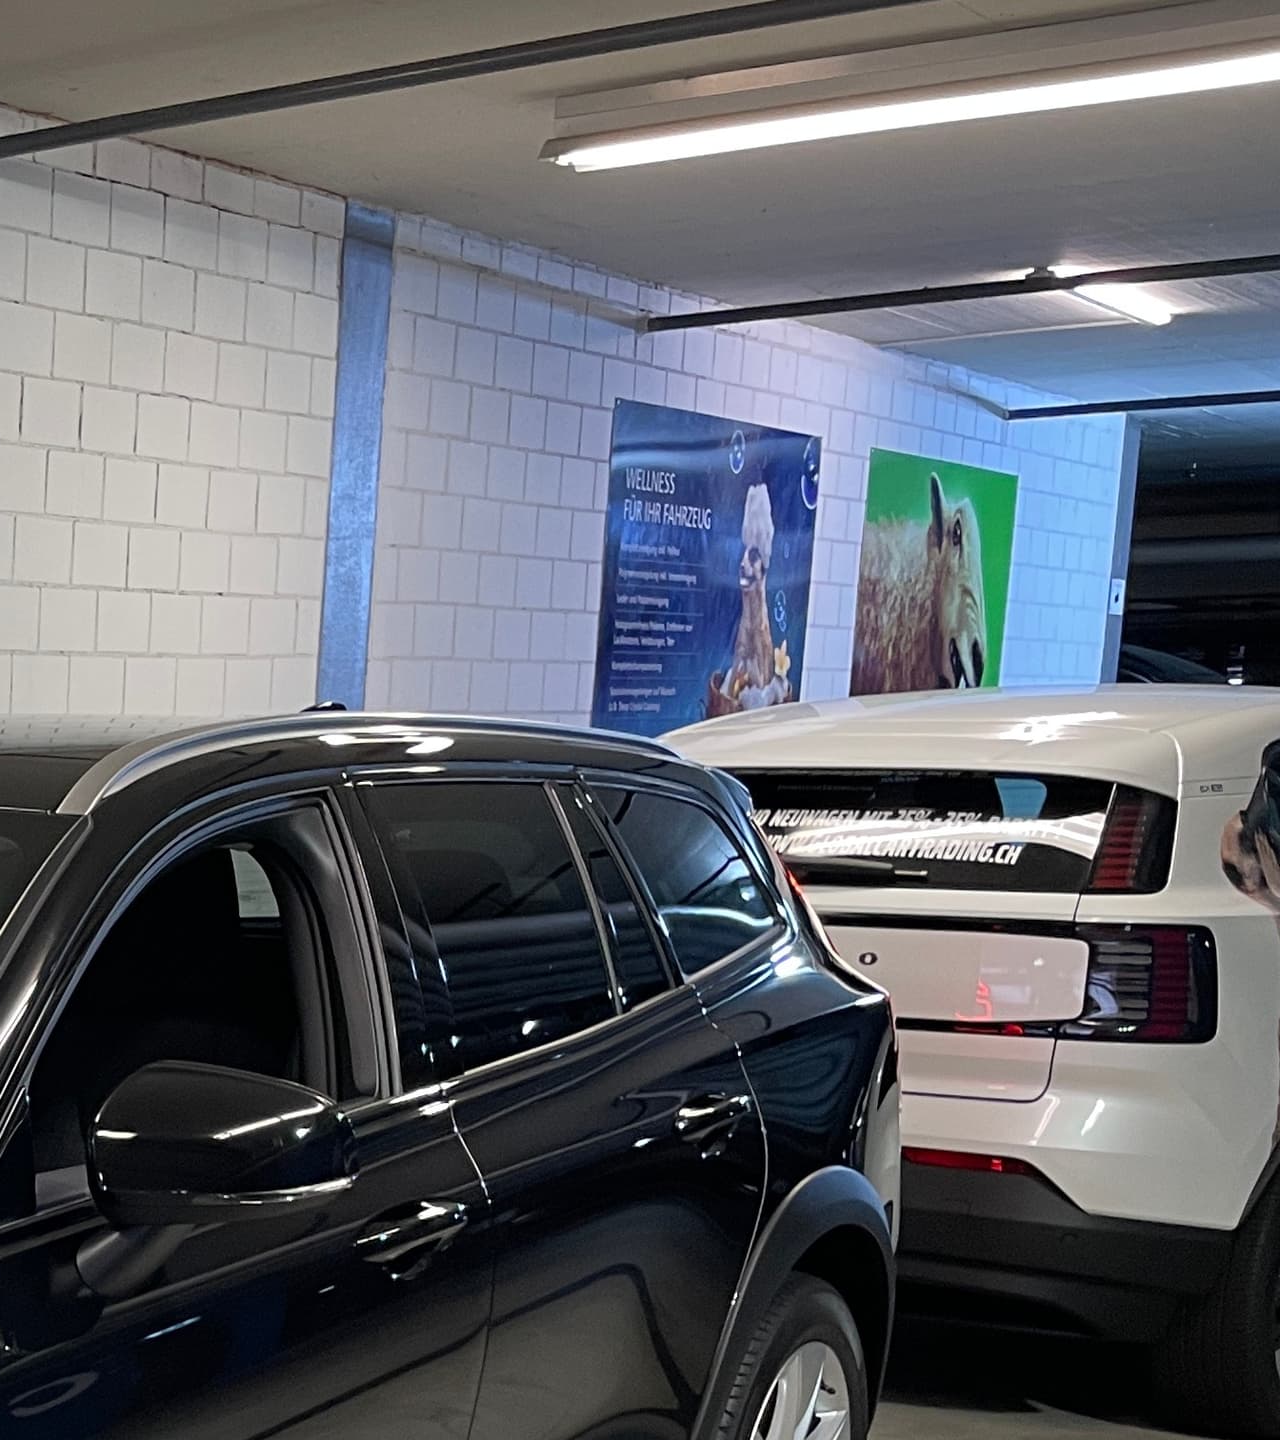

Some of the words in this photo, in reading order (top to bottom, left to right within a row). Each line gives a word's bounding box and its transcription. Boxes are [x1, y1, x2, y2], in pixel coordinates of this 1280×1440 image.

[625, 467, 676, 494] WELLNESS
[623, 494, 643, 522] FÜR
[644, 500, 662, 524] IHR
[663, 503, 712, 530] FAHRZEUG
